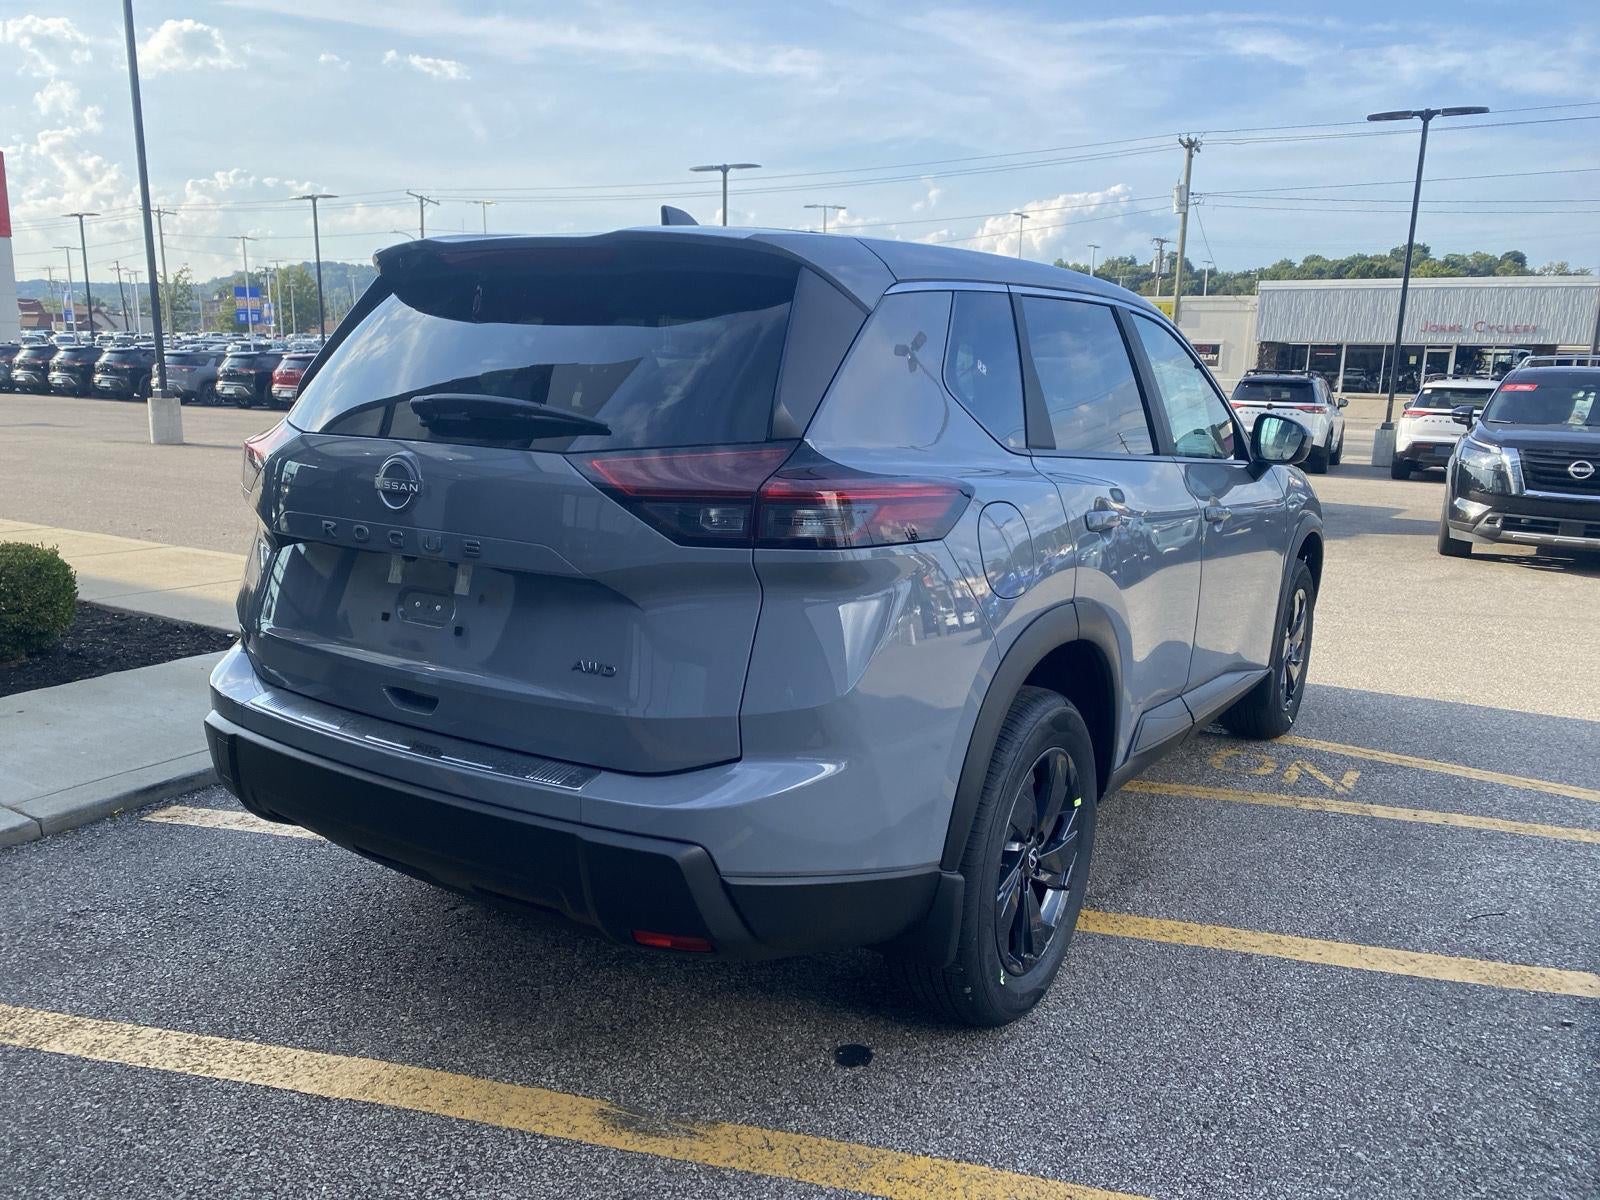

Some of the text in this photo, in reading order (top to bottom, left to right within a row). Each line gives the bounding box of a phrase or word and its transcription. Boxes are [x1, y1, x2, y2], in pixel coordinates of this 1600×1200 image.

[375, 479, 419, 492] NISSAN
[321, 520, 481, 557] ROGUE
[571, 659, 617, 677] AWD
